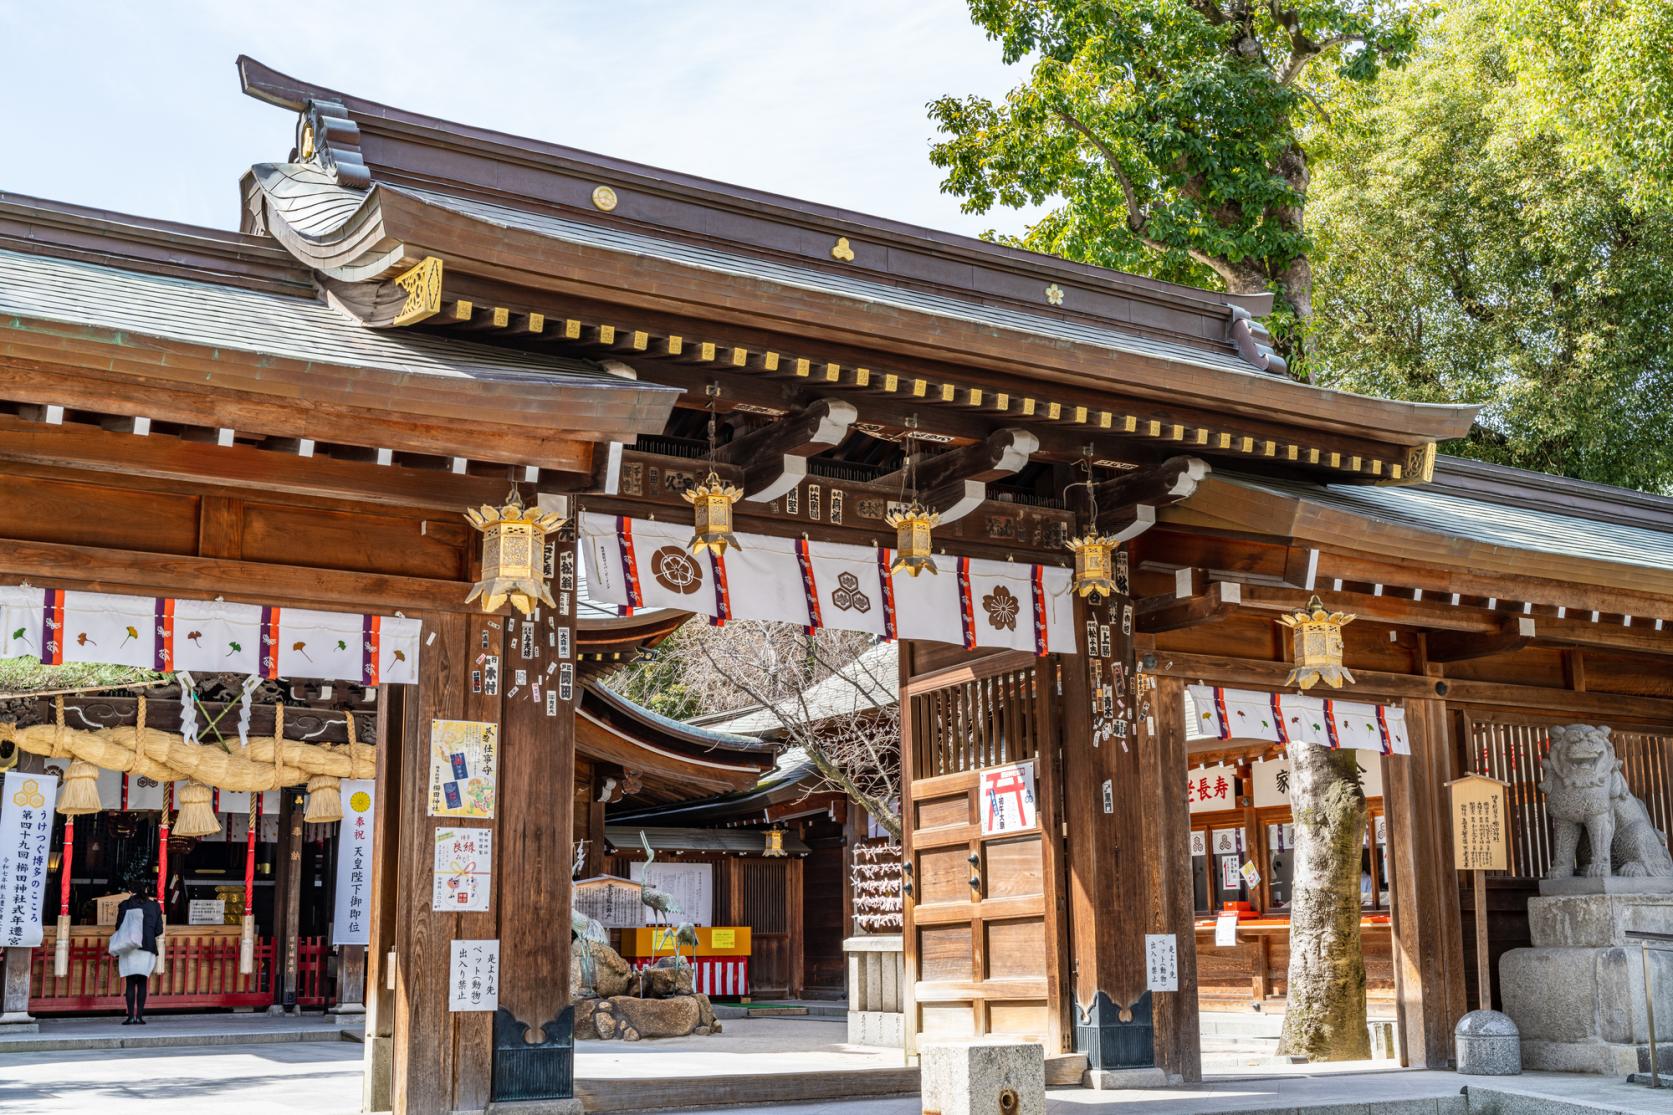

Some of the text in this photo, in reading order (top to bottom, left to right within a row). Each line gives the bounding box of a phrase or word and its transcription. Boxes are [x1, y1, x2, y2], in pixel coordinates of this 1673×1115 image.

[8, 810, 33, 946] 第四十九回 櫛田神社式年遷宮
[30, 810, 48, 923] うけつぐ博多のこころ
[349, 816, 366, 933] 奉祝 天皇陛下御即位
[457, 948, 468, 1000] 出入り禁止
[486, 954, 497, 996] 是より先
[1151, 941, 1159, 983] 出入り禁止
